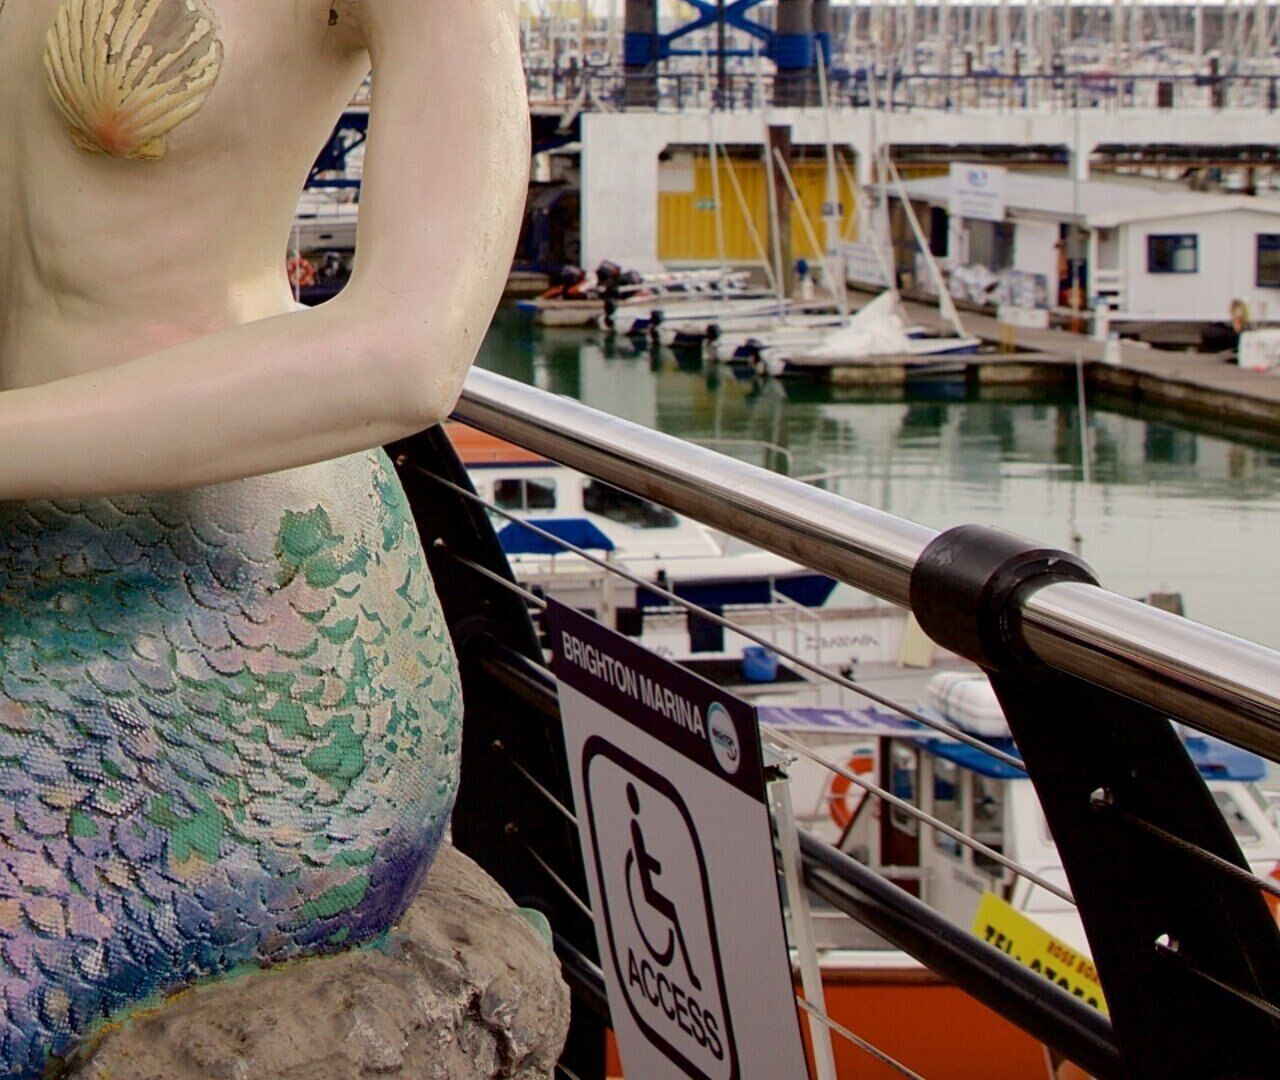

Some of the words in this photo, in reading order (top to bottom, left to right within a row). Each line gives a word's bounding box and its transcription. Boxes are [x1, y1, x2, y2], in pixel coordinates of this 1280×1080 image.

[561, 631, 639, 700] BRIGHTON
[639, 674, 707, 740] MARINA
[628, 948, 724, 1061] ACCESS
